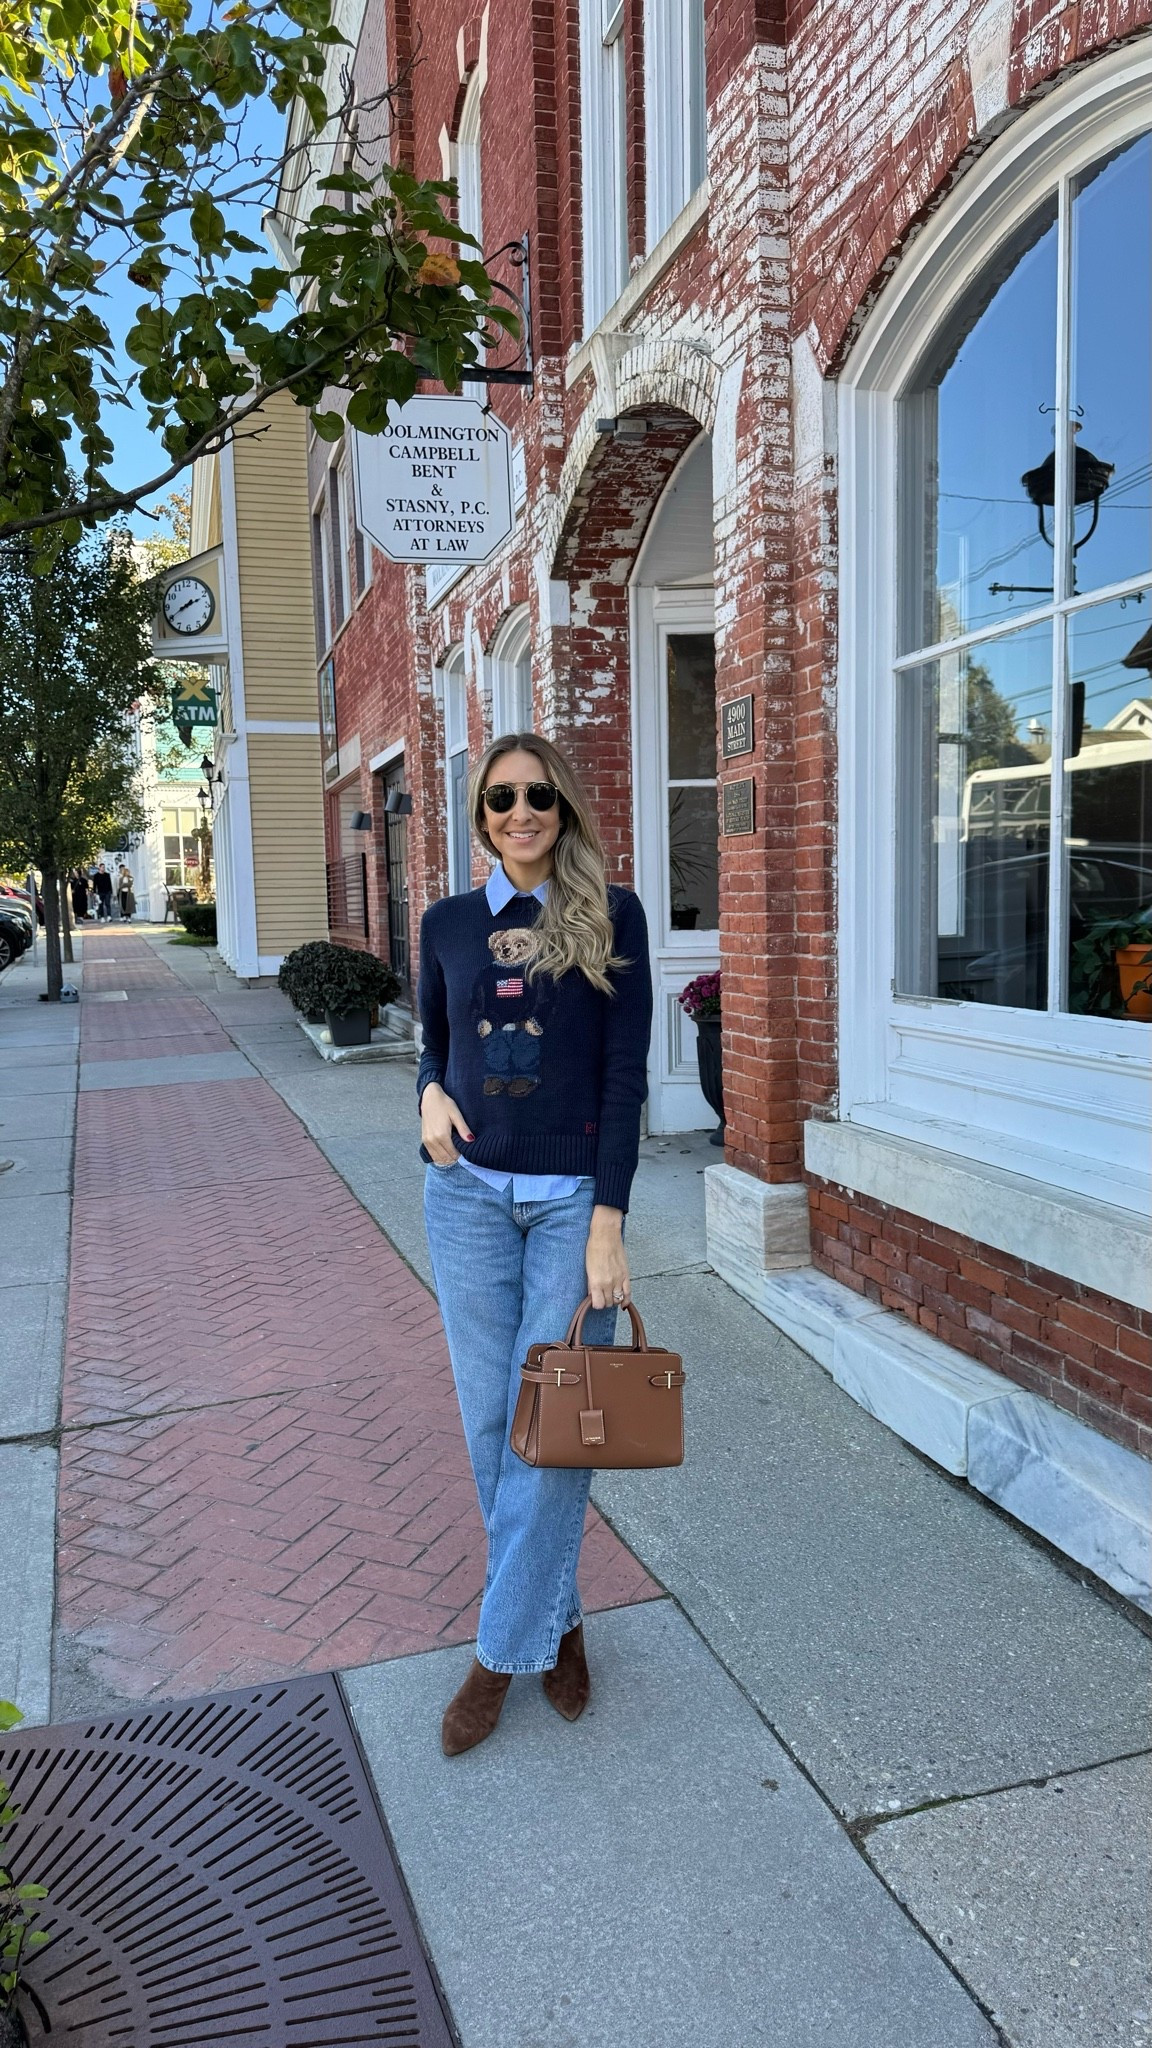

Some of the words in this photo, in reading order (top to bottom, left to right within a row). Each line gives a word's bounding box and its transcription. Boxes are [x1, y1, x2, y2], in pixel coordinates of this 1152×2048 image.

[371, 424, 500, 442] OOLMINGTON
[389, 445, 480, 462] CAMPBELL
[411, 464, 457, 479] BENT
[431, 484, 443, 497] &
[386, 498, 455, 517] STASNY,
[461, 501, 490, 516] P.C.
[393, 518, 485, 534] ATTORNEYS
[410, 538, 430, 551] AT
[436, 538, 470, 552] LAW
[182, 580, 191, 588] 12
[194, 582, 198, 590] 1
[168, 593, 176, 601] 10
[164, 603, 170, 611] 9
[177, 622, 182, 630] 7
[175, 705, 216, 721] ATM
[727, 703, 746, 724] 4900
[727, 721, 746, 740] MAIN
